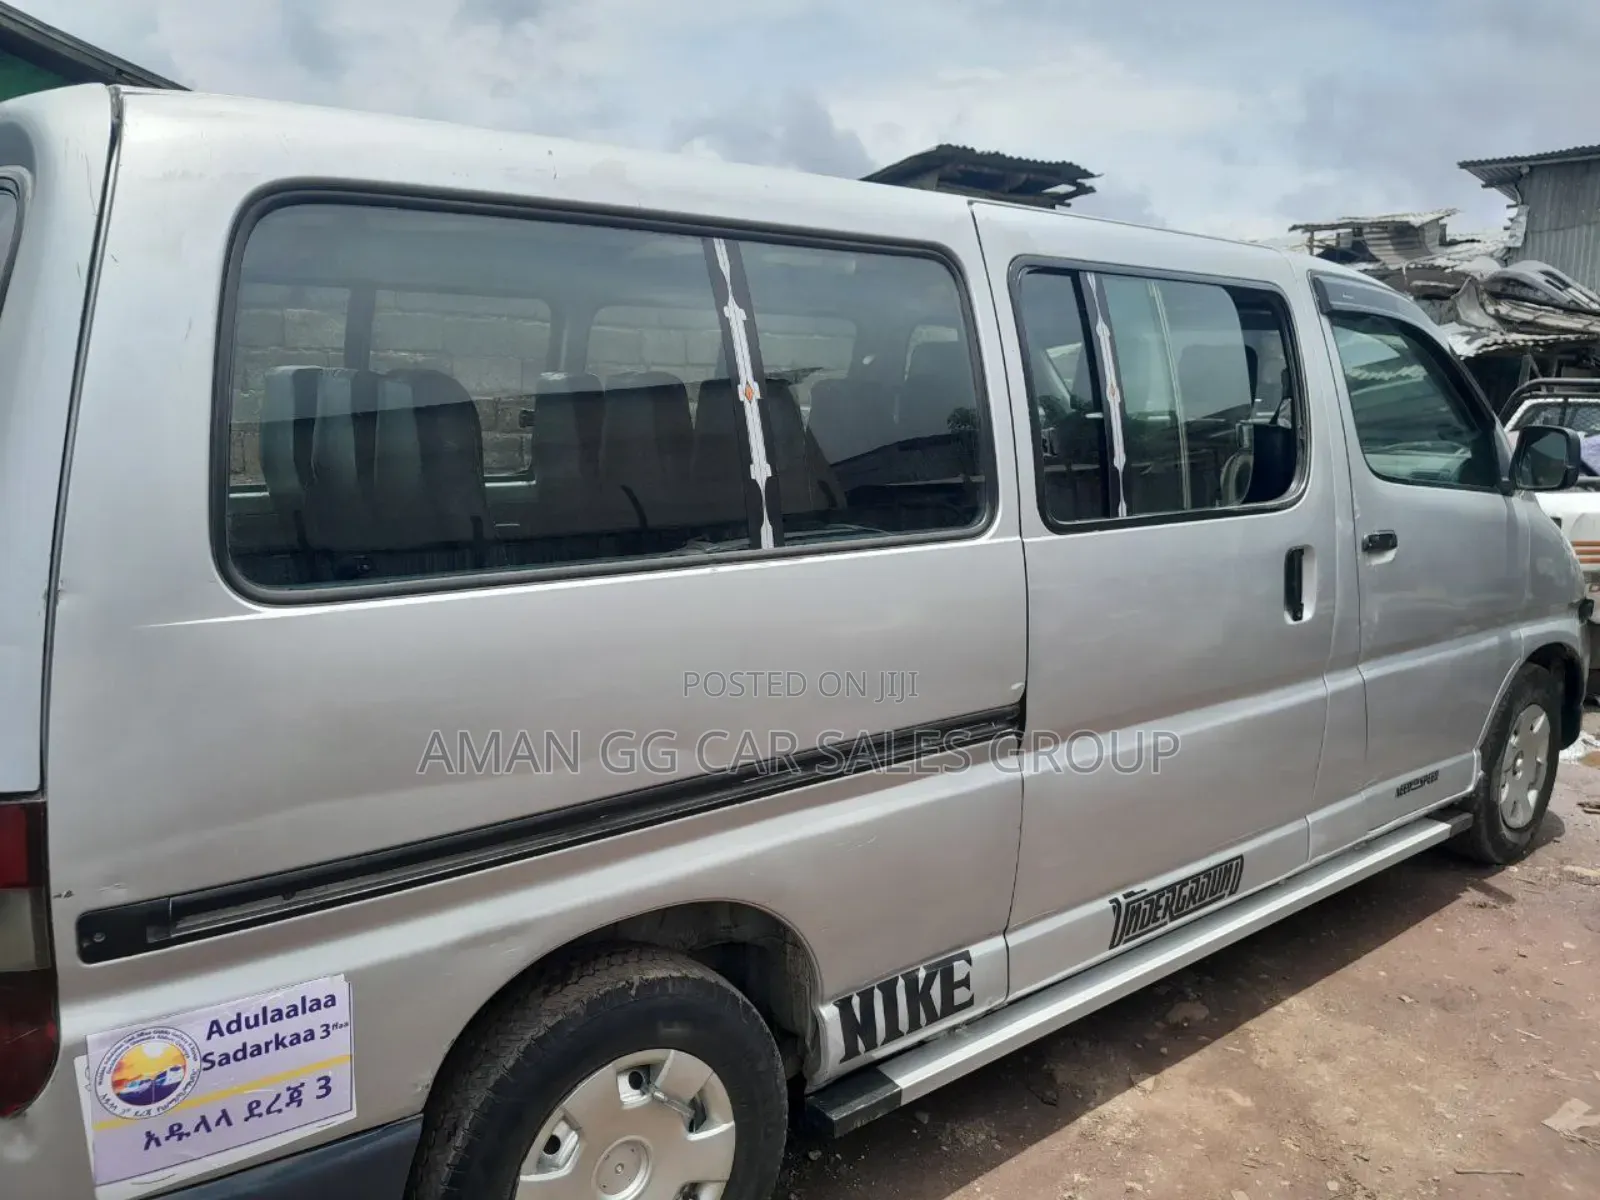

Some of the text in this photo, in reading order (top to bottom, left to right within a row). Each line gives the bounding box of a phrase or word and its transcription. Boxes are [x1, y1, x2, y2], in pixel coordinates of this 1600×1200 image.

[205, 993, 337, 1041] Adulaalaa
[832, 949, 974, 1064] NIKE
[200, 1028, 316, 1072] Sadarkaa
[315, 1075, 332, 1100] 3
